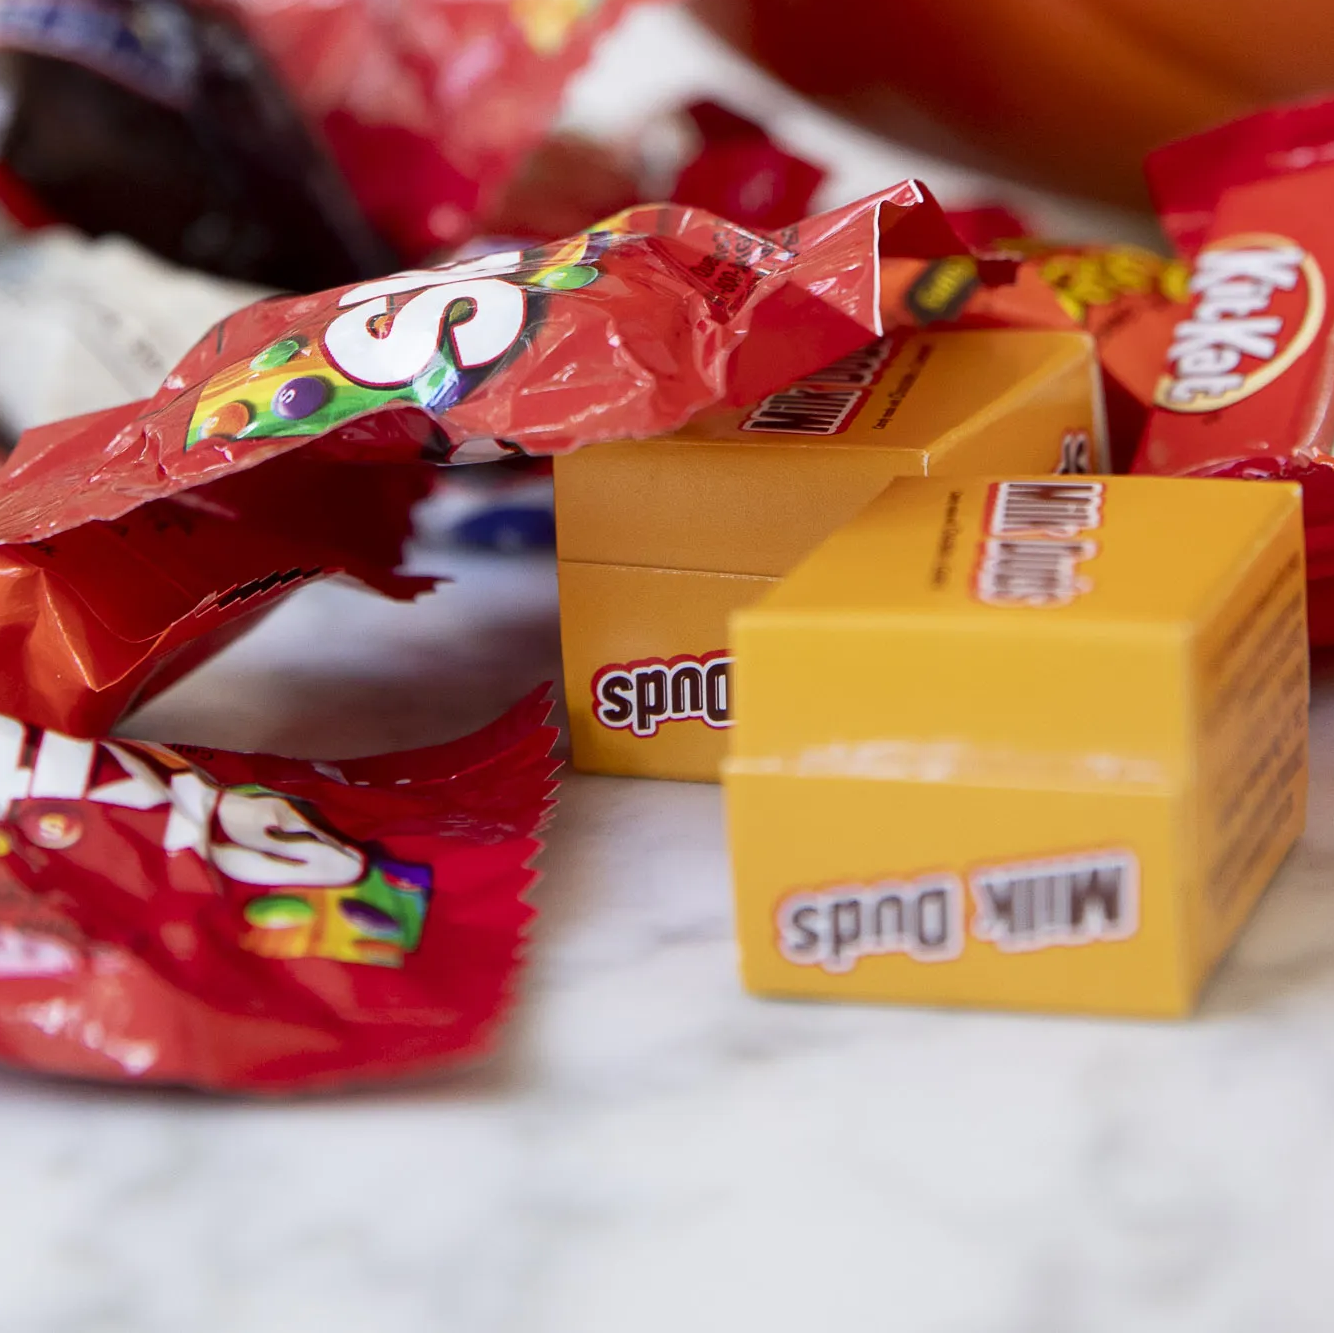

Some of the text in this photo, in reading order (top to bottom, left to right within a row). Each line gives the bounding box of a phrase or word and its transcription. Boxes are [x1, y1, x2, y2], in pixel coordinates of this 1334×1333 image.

[989, 482, 1098, 601] Milk Duds
[784, 857, 1131, 967] Milk Duds
